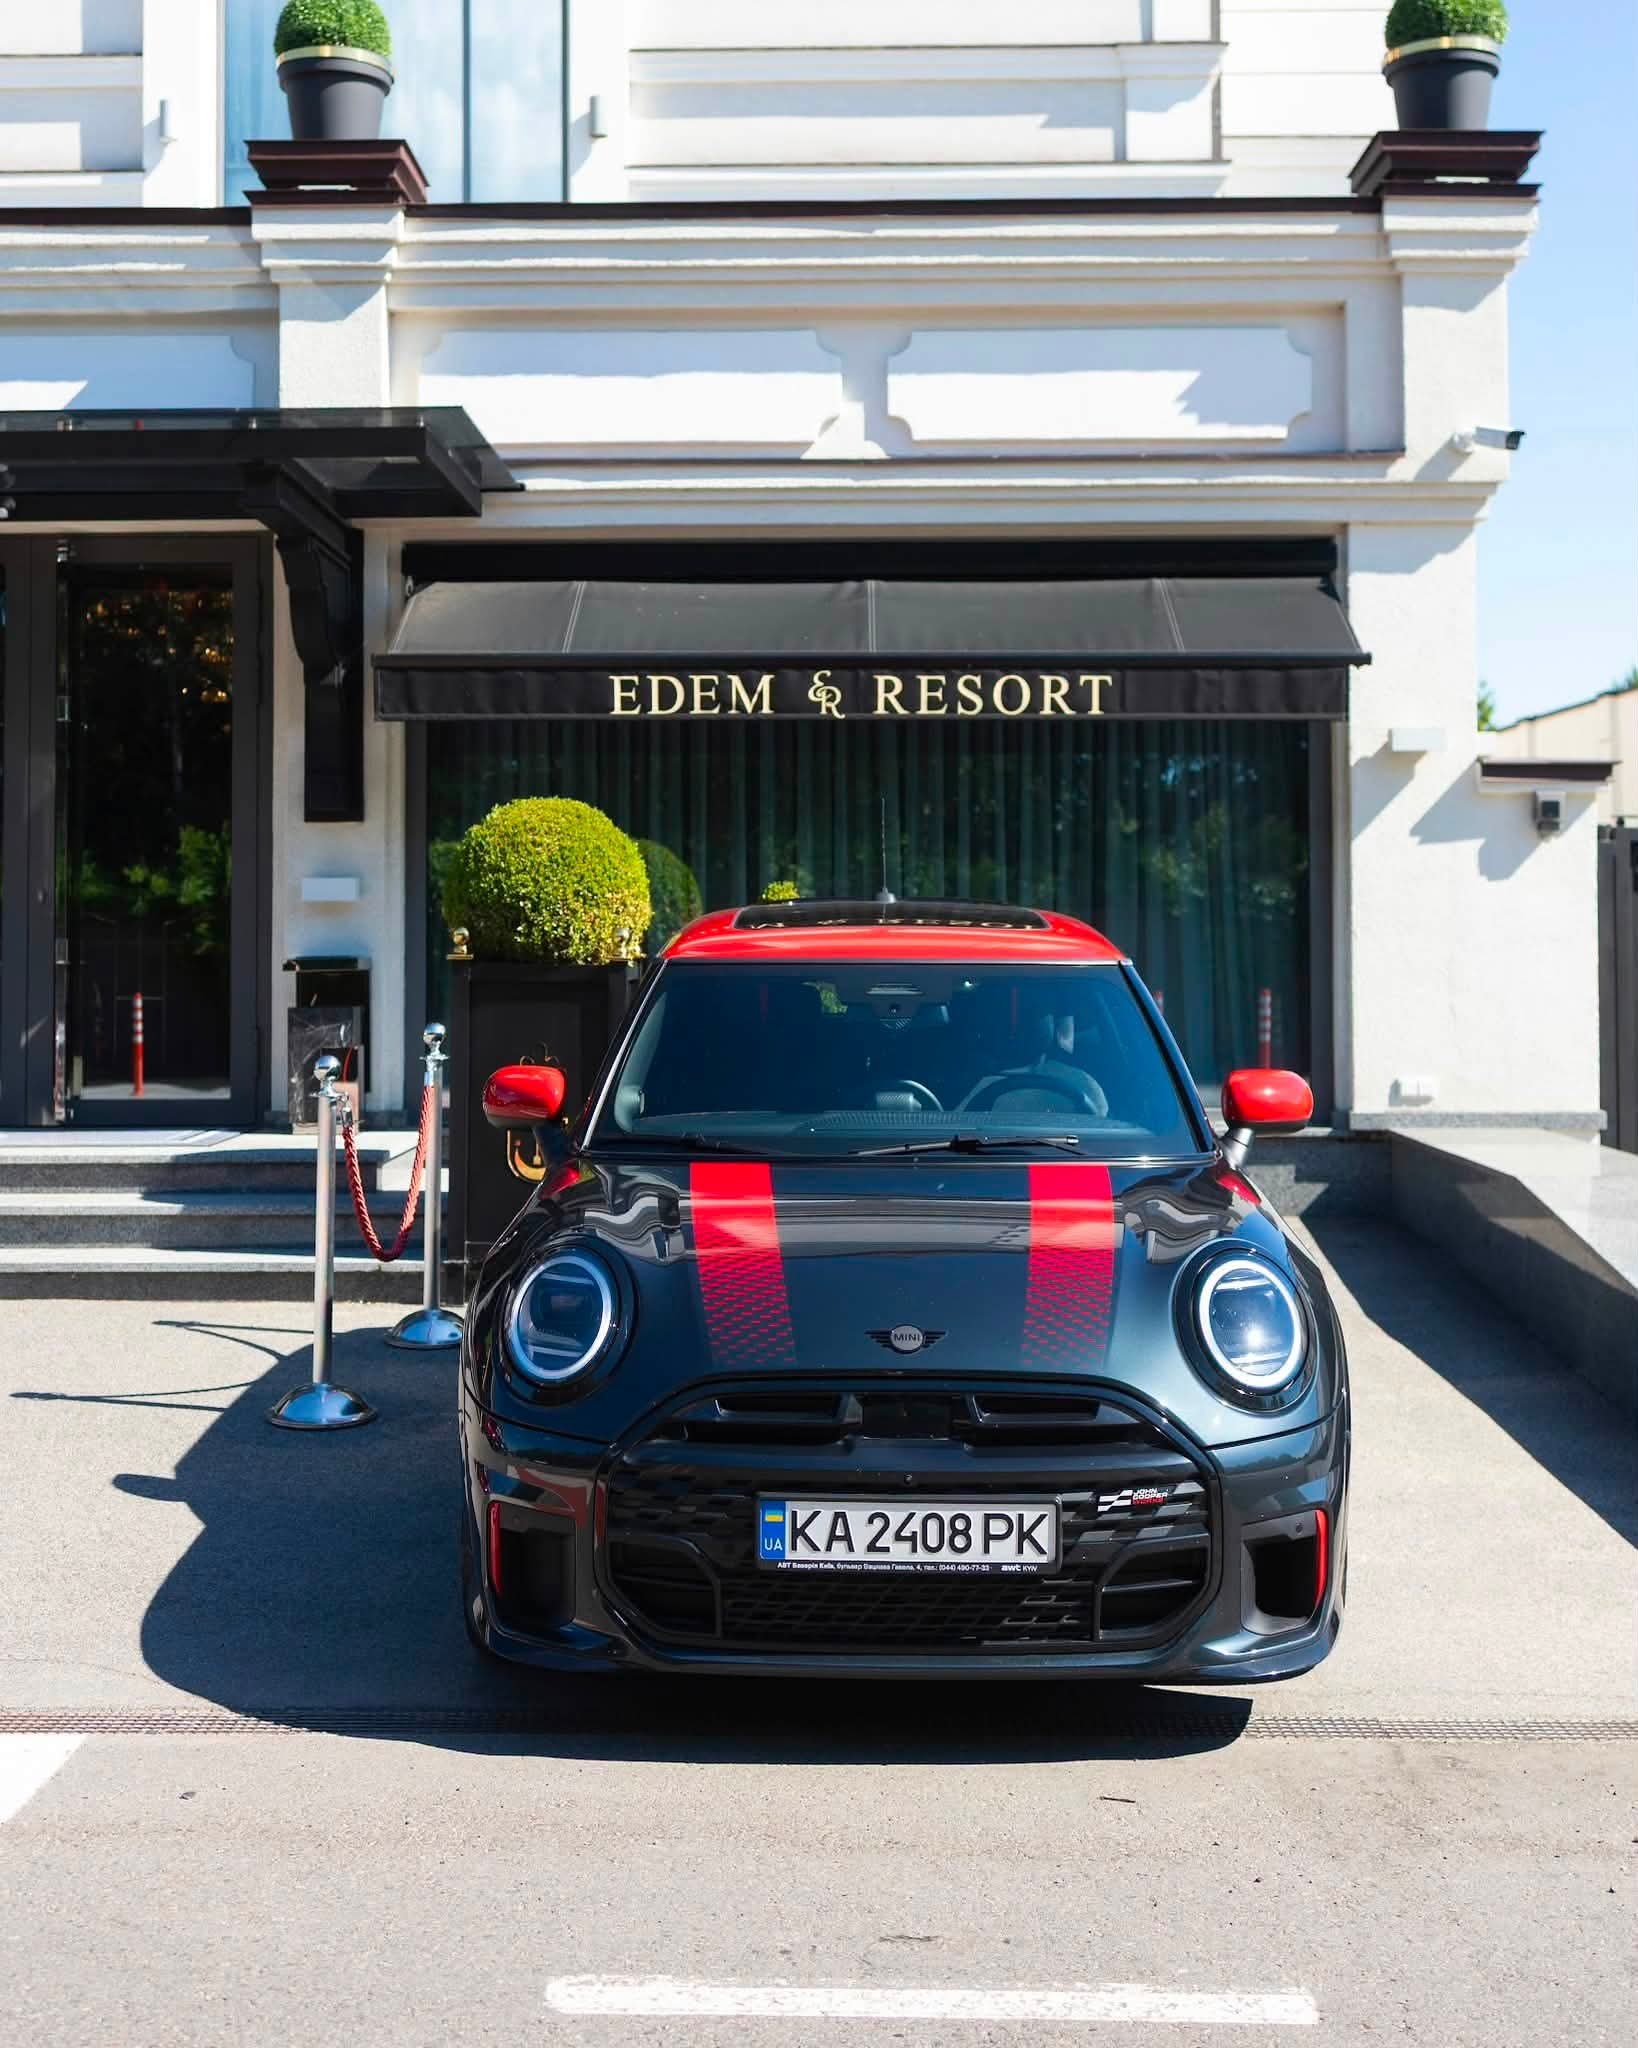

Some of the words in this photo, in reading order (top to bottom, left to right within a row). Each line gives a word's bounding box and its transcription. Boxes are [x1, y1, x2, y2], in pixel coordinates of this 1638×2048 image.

[608, 674, 775, 716] EDEM
[872, 674, 1113, 716] RESORT
[893, 1333, 921, 1342] MINI
[1132, 1492, 1168, 1500] COOPER
[791, 1510, 856, 1553] KA
[865, 1512, 973, 1554] 2408
[983, 1513, 1049, 1556] PK
[764, 1539, 783, 1551] UA
